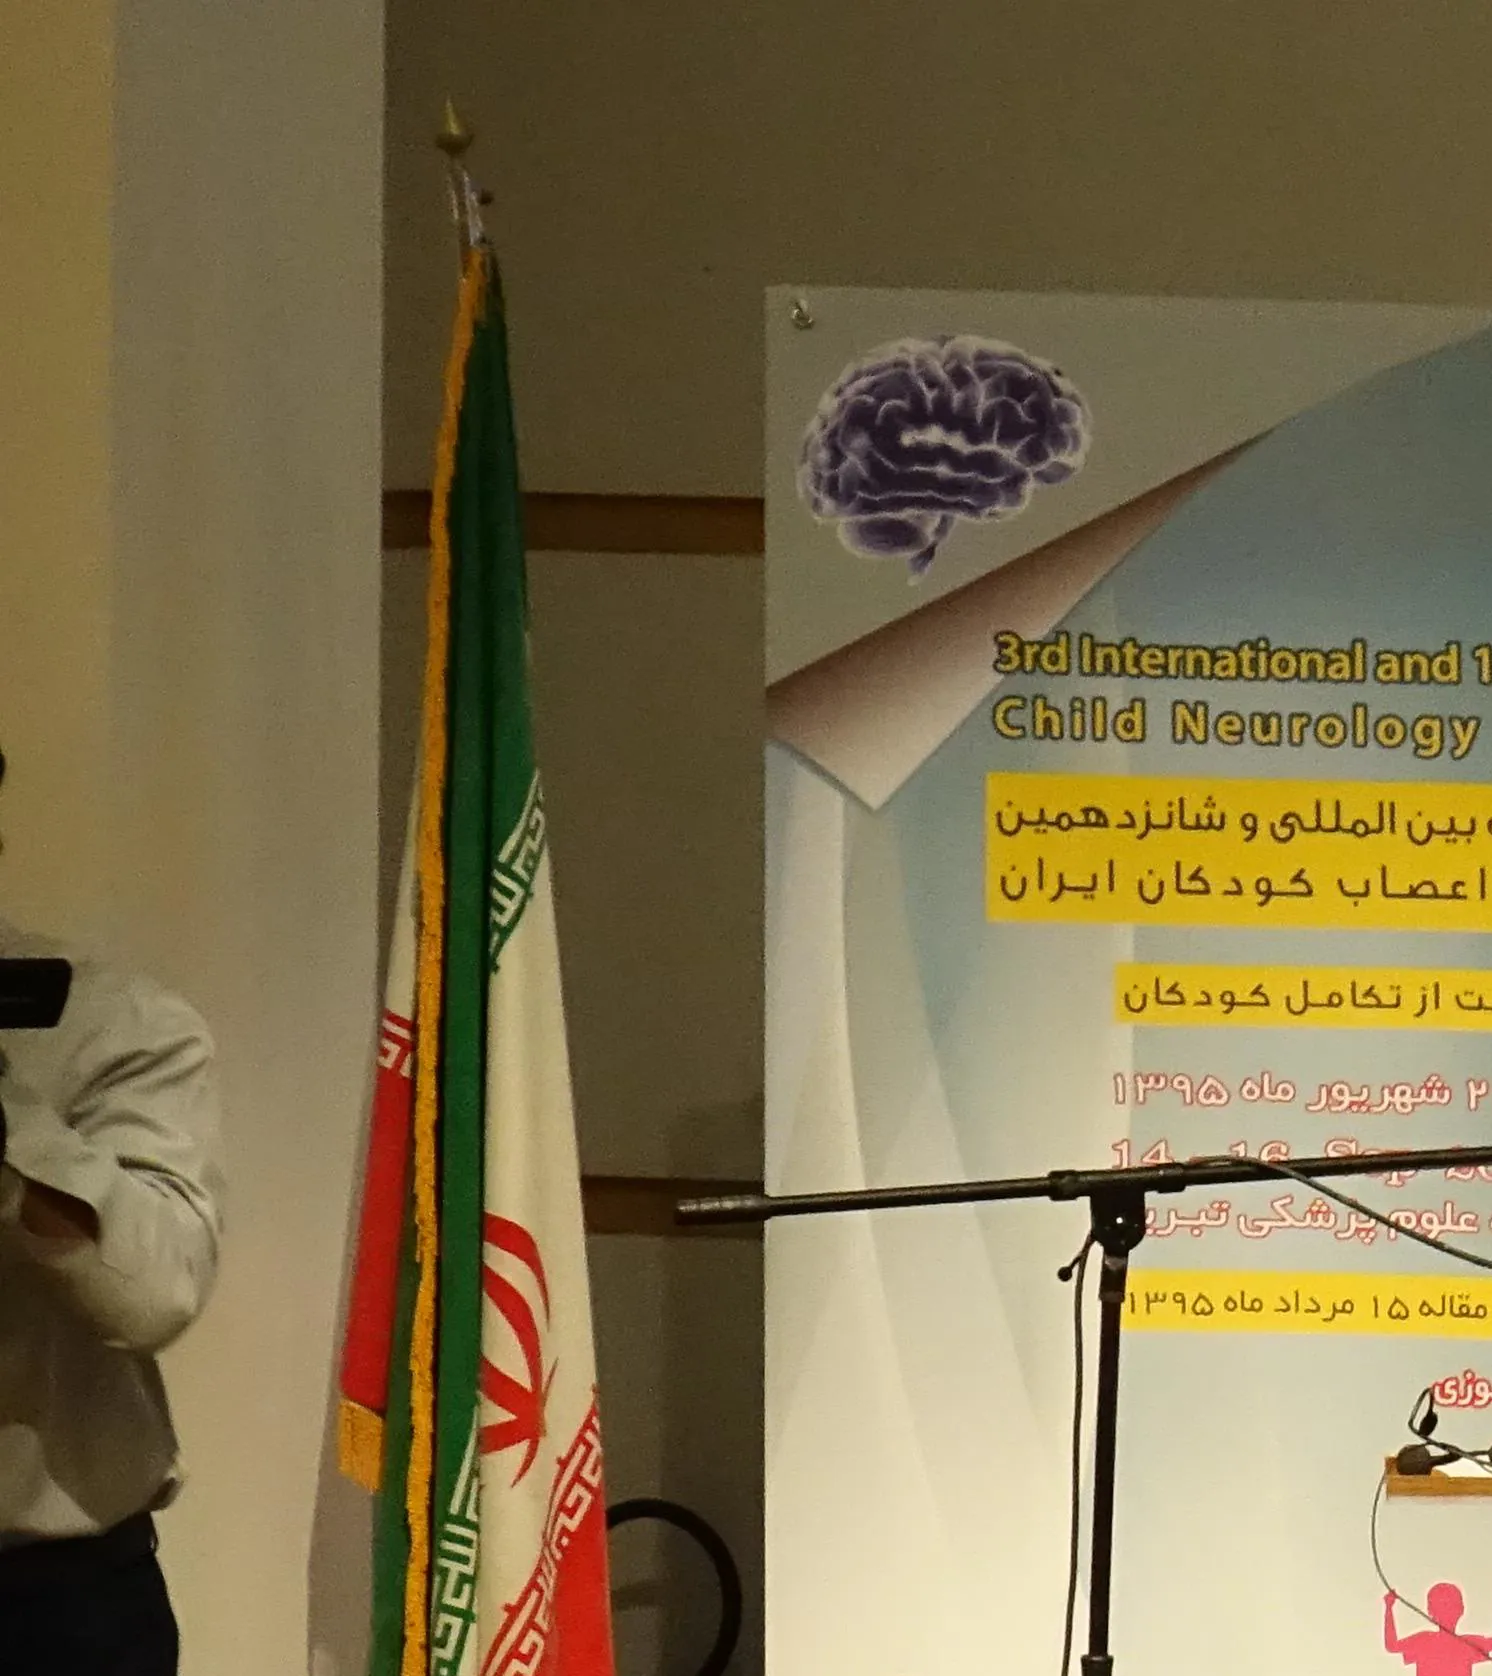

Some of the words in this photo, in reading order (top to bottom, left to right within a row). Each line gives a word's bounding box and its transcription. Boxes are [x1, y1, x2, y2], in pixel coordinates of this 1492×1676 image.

[993, 630, 1070, 675] 3rd
[1078, 632, 1367, 682] International
[1374, 640, 1461, 685] and
[992, 694, 1147, 743] Child
[1171, 700, 1481, 760] Neurology
[1240, 811, 1259, 843] و
[1270, 798, 1396, 843] المللی
[1406, 809, 1477, 846] بین
[1000, 856, 1116, 901] ایران
[1137, 860, 1315, 905] کودکان
[1338, 863, 1487, 907] اعصاب
[1123, 976, 1271, 1013] کودکان
[1285, 979, 1402, 1016] تکامل
[1413, 981, 1441, 1018] از
[1113, 1071, 1230, 1106] ۱۳۹۵
[1239, 1071, 1296, 1104] ماه
[1306, 1073, 1452, 1114] شهریور
[1325, 1138, 1418, 1188] Sp
[1145, 1199, 1231, 1238] تبری
[1387, 1200, 1480, 1241] علوم
[1128, 1290, 1215, 1317] ۱۳۹۵
[1223, 1289, 1264, 1314] ماه
[1274, 1290, 1355, 1323] مرداد
[1373, 1294, 1410, 1321] ۱۵
[1418, 1292, 1488, 1320] مقاله
